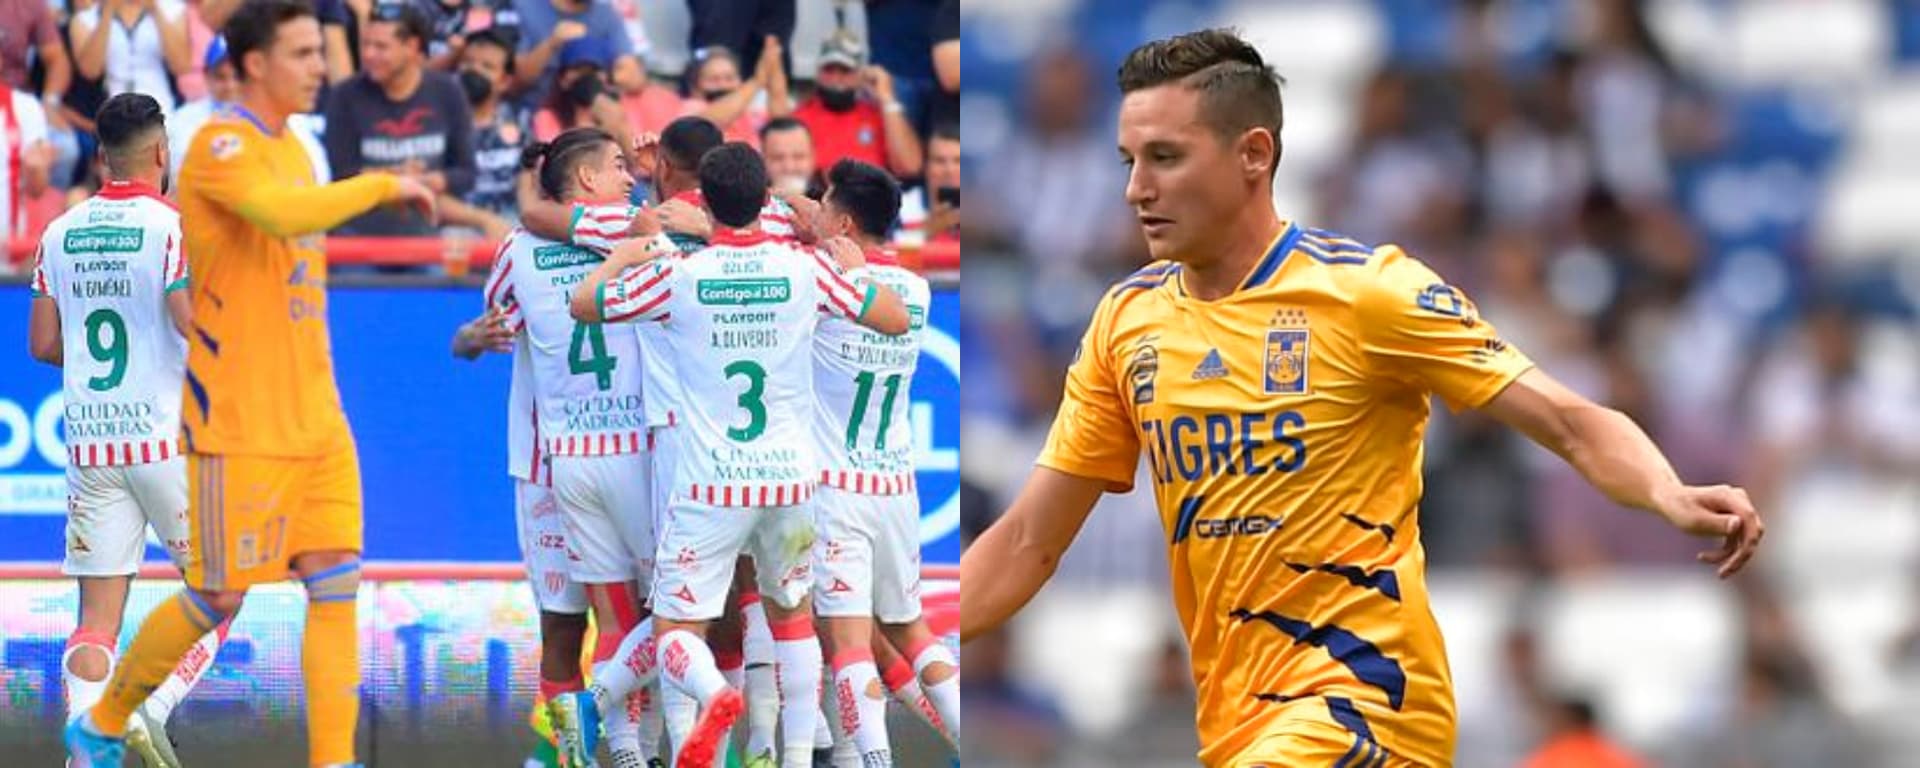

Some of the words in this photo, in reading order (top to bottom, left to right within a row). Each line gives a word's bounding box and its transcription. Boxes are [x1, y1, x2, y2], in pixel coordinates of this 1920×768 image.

[551, 274, 585, 286] PLAY
[700, 287, 751, 303] Contigo
[762, 286, 787, 298] 100
[84, 309, 129, 391] 9
[568, 320, 617, 391] 4
[65, 402, 151, 421] CIUDAD
[68, 421, 153, 437] MADERAS
[724, 360, 768, 442] 3
[846, 370, 901, 450] 11
[1141, 411, 1307, 485] TIGRES
